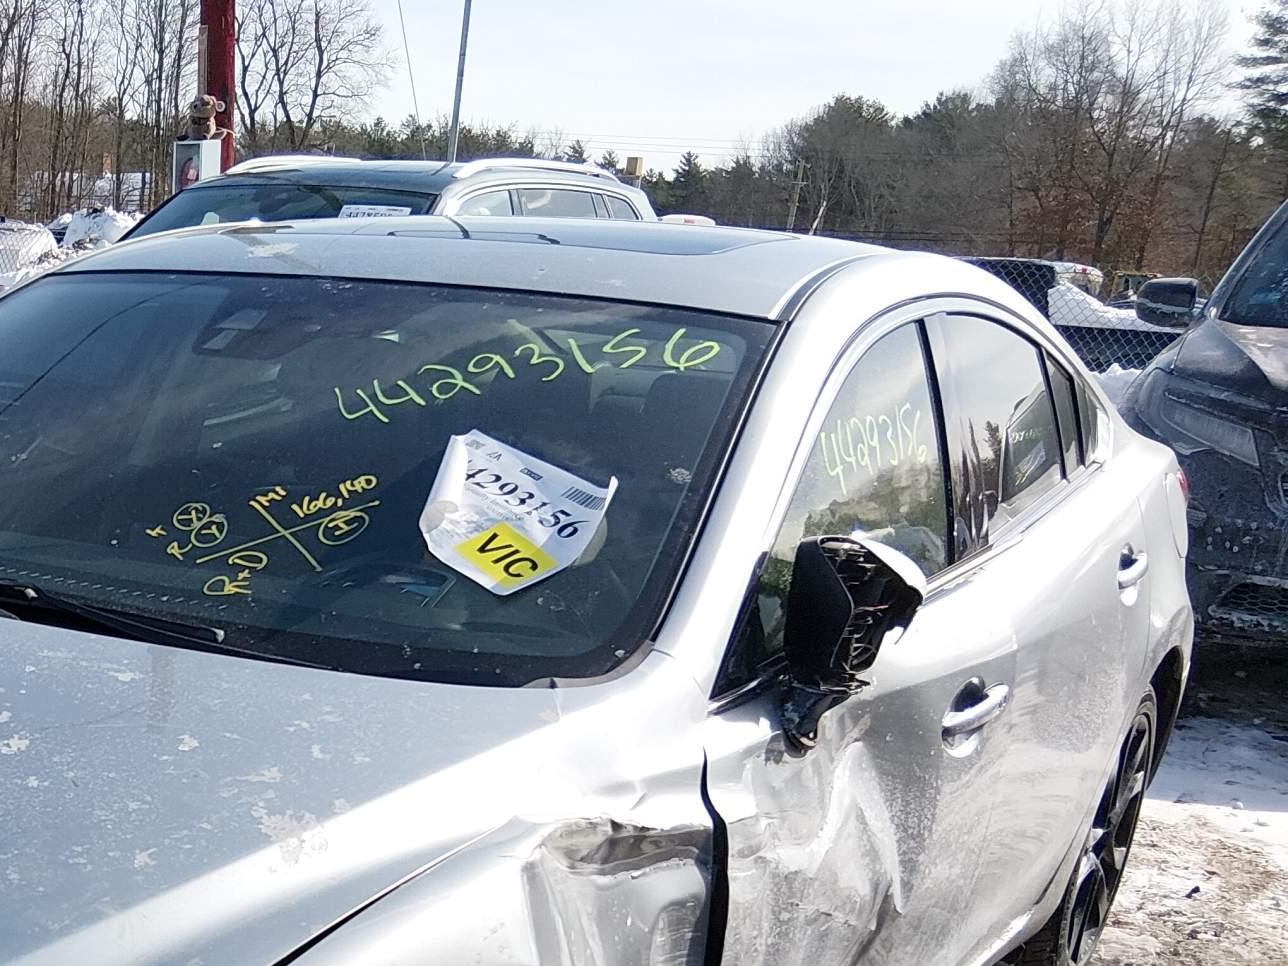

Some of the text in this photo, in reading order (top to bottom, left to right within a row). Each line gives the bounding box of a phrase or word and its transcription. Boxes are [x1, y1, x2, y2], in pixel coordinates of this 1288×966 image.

[334, 328, 720, 423] 44293156
[820, 402, 928, 496] 44293156
[466, 460, 590, 538] 4293156
[476, 531, 539, 578] VIC
